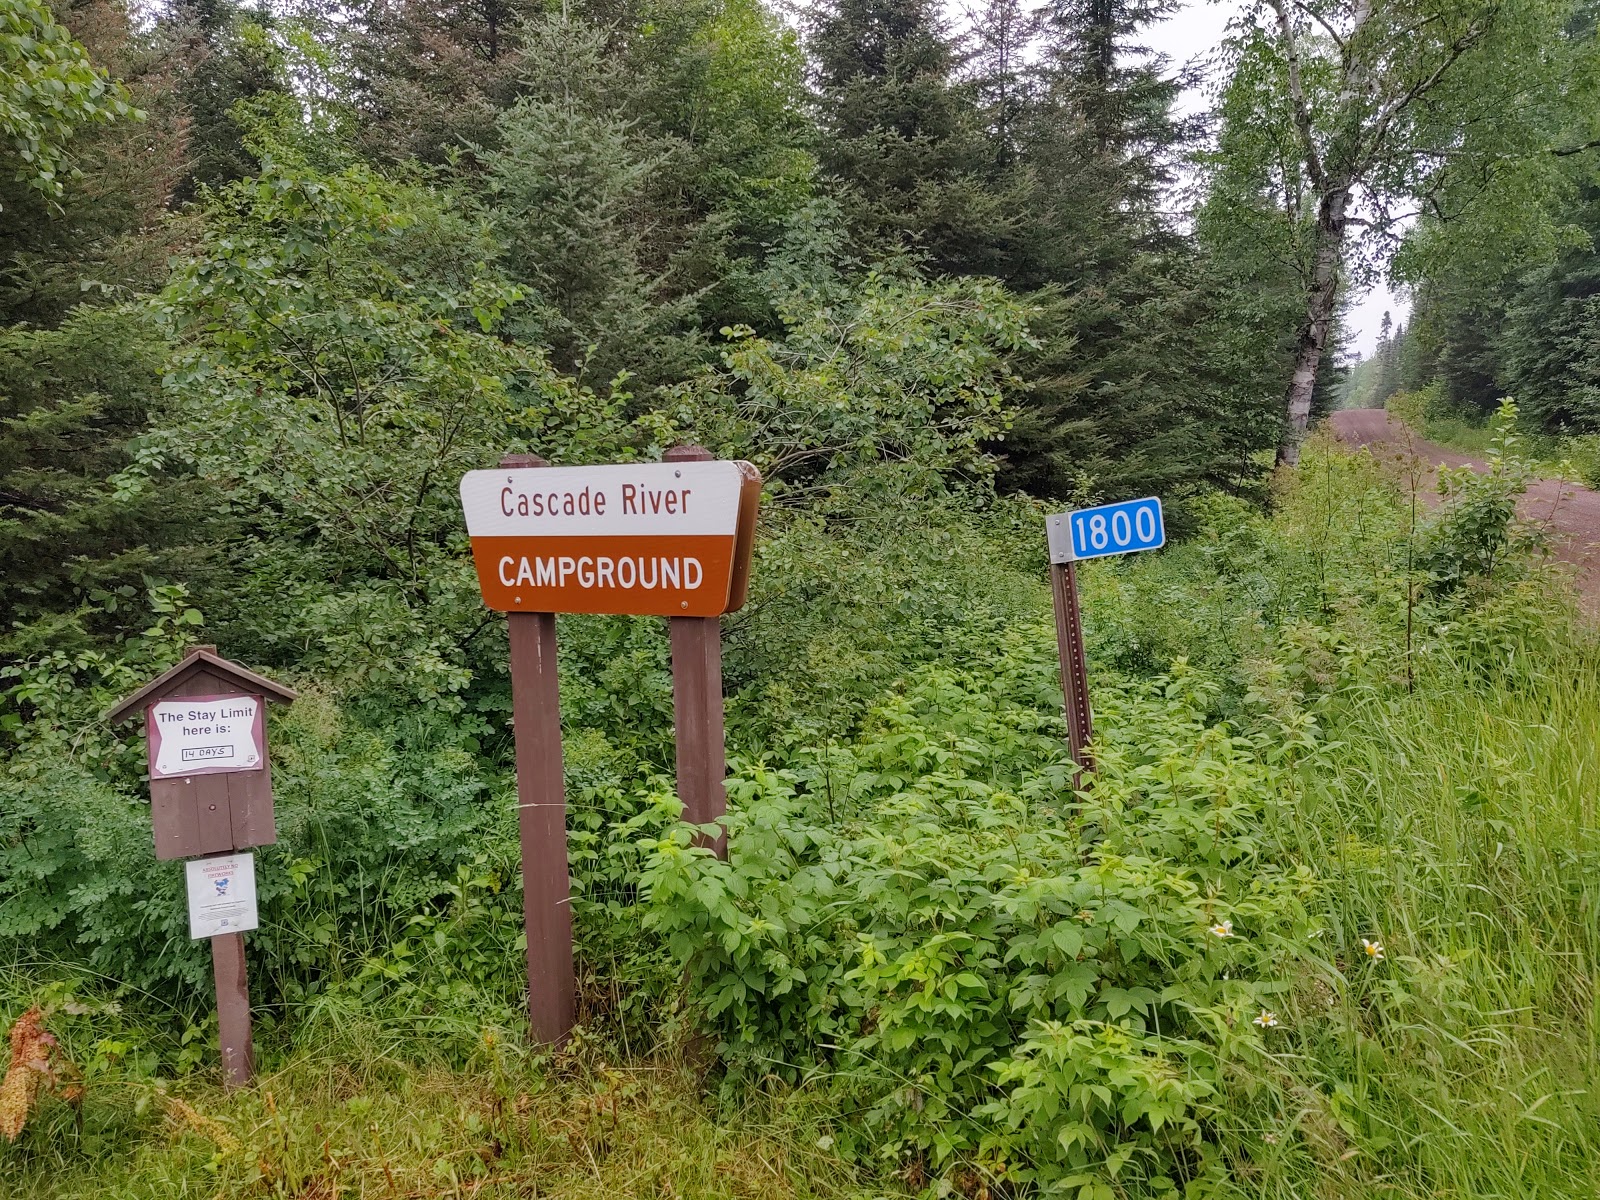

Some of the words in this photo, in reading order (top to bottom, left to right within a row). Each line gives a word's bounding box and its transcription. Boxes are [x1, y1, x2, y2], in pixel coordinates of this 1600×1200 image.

[501, 485, 606, 517] Cascade
[622, 483, 691, 515] River
[1076, 506, 1156, 551] 1800
[498, 555, 703, 590] CAMPGROUND
[159, 712, 184, 722] The
[188, 710, 216, 722] Stay
[220, 707, 253, 719] Limit
[183, 725, 211, 736] here
[215, 723, 231, 734] is:
[185, 750, 195, 758] 14
[199, 747, 225, 756] DAYS
